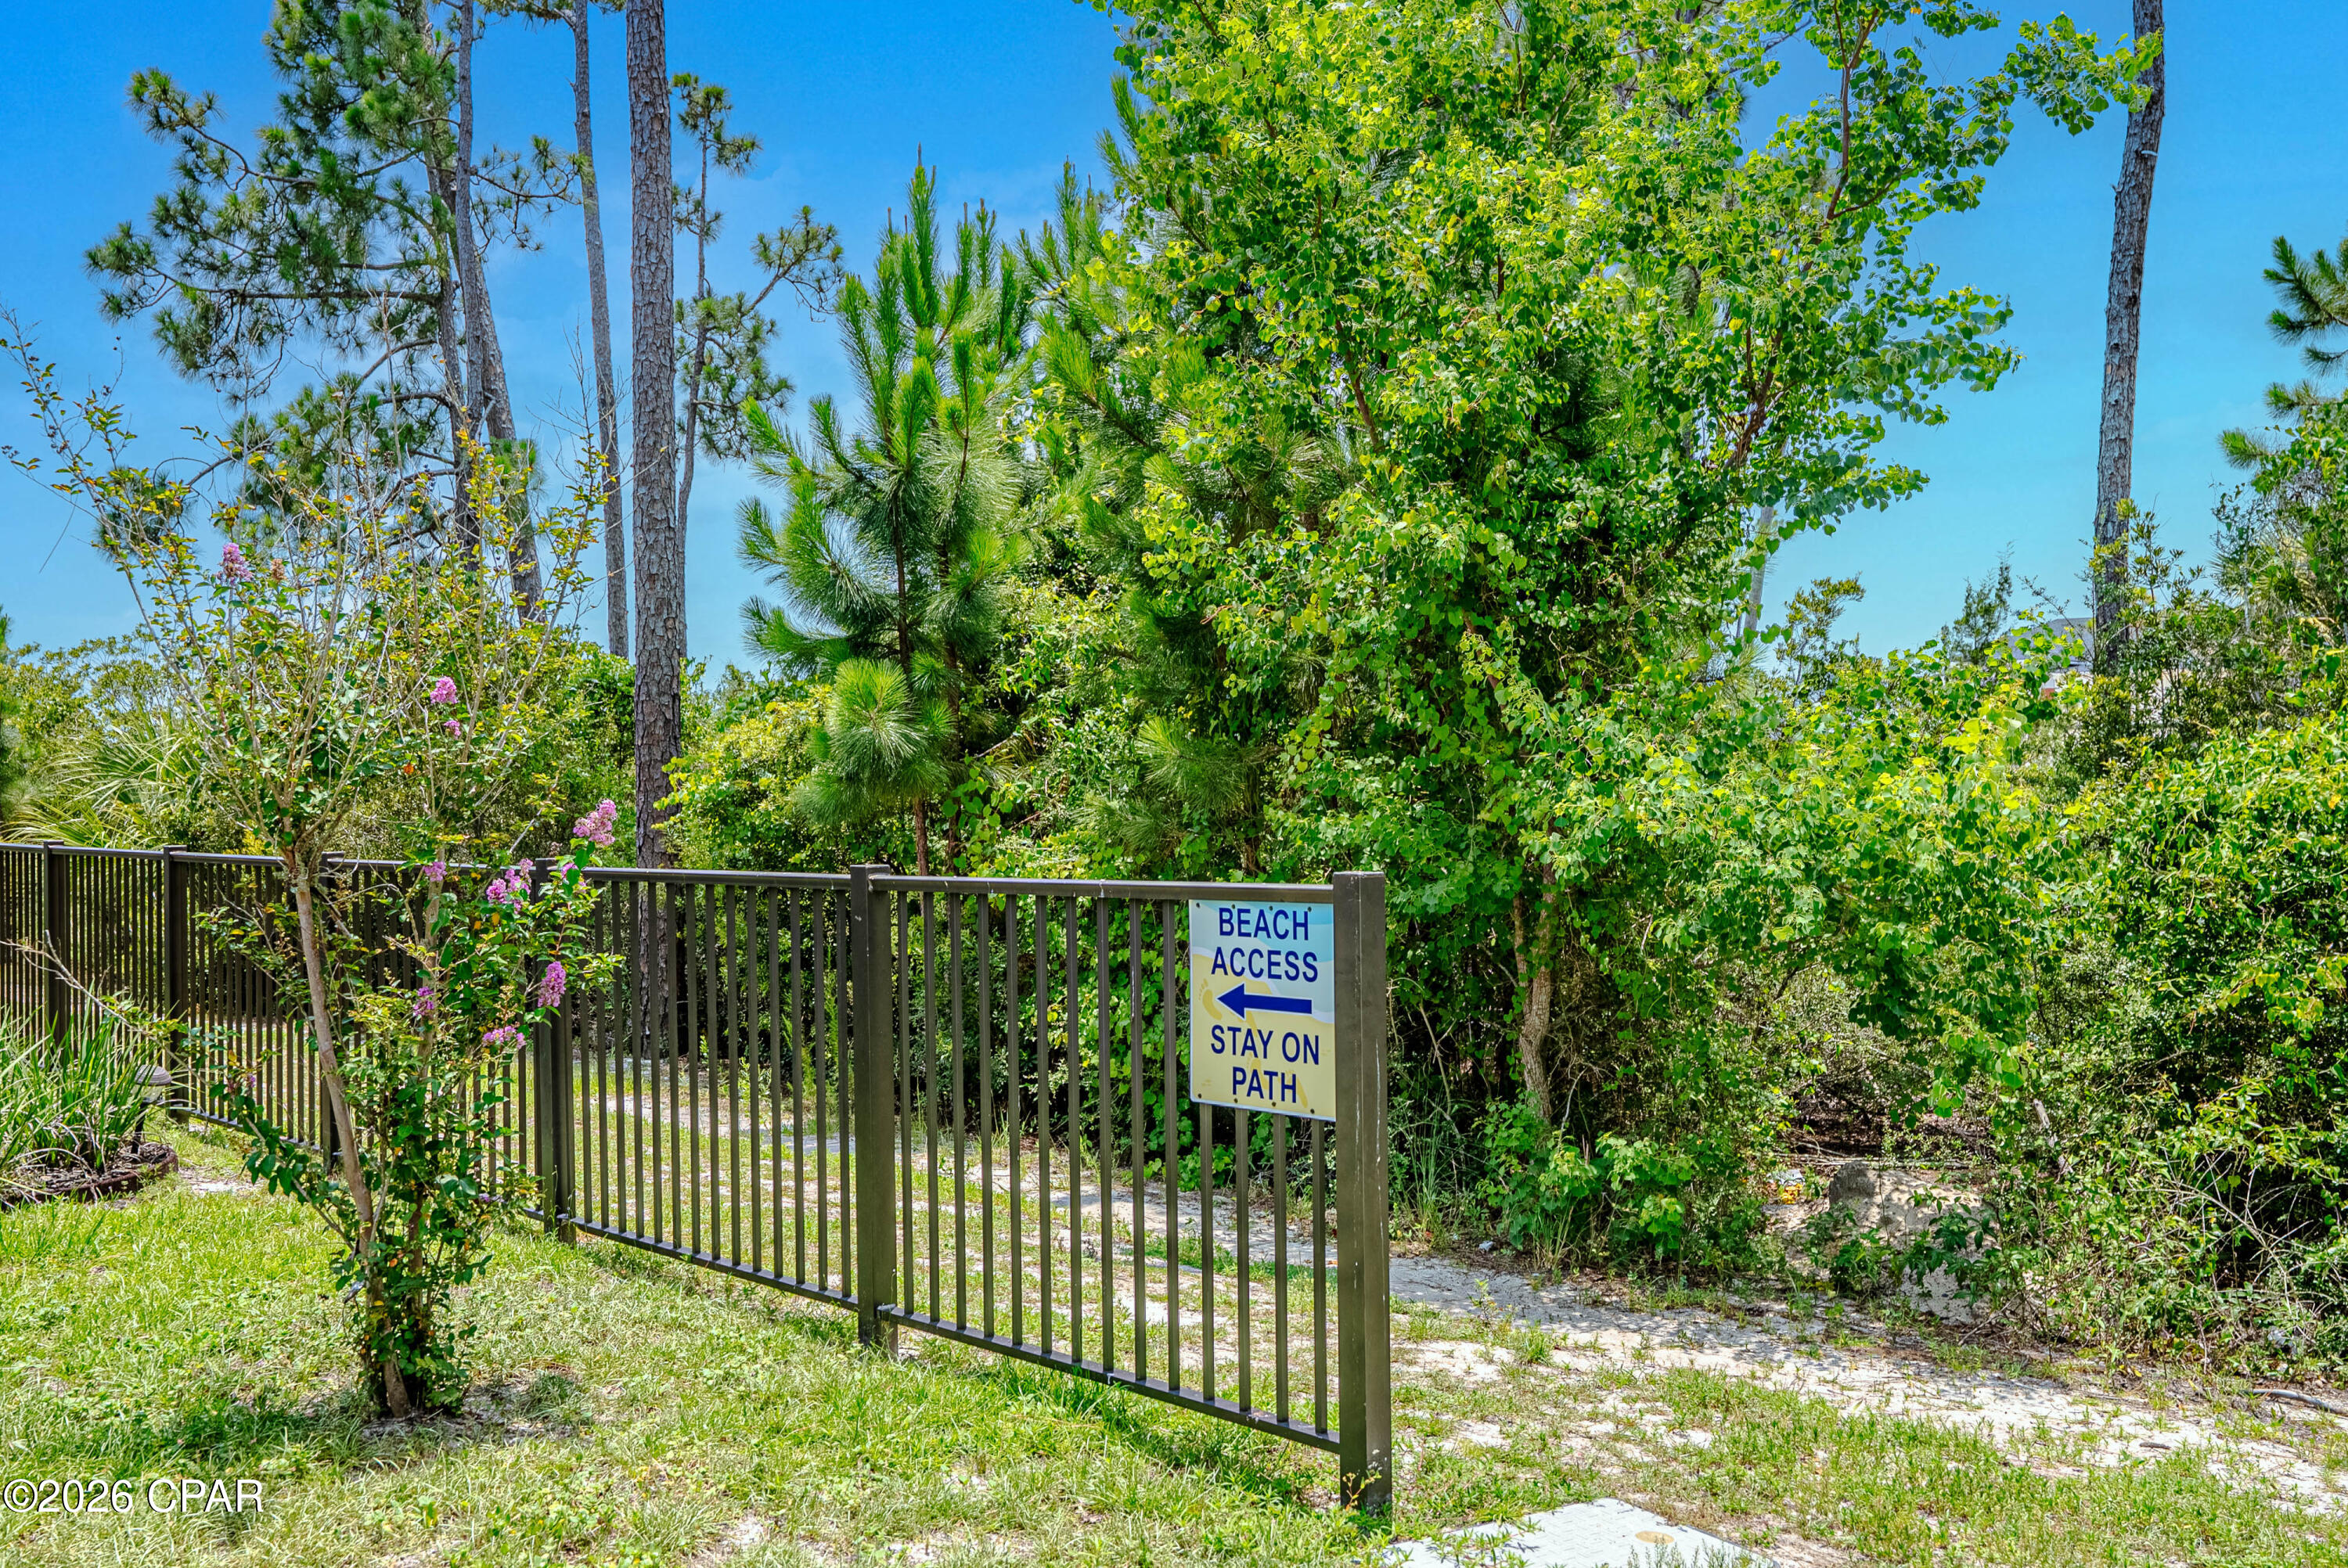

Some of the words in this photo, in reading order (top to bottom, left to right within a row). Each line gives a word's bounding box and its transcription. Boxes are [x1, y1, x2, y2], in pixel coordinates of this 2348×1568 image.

[1219, 907, 1309, 941] BEACH
[1211, 946, 1318, 983] ACCESS
[1210, 1024, 1274, 1059] STAY
[1281, 1031, 1320, 1066] ON
[1232, 1066, 1297, 1103] PATH
